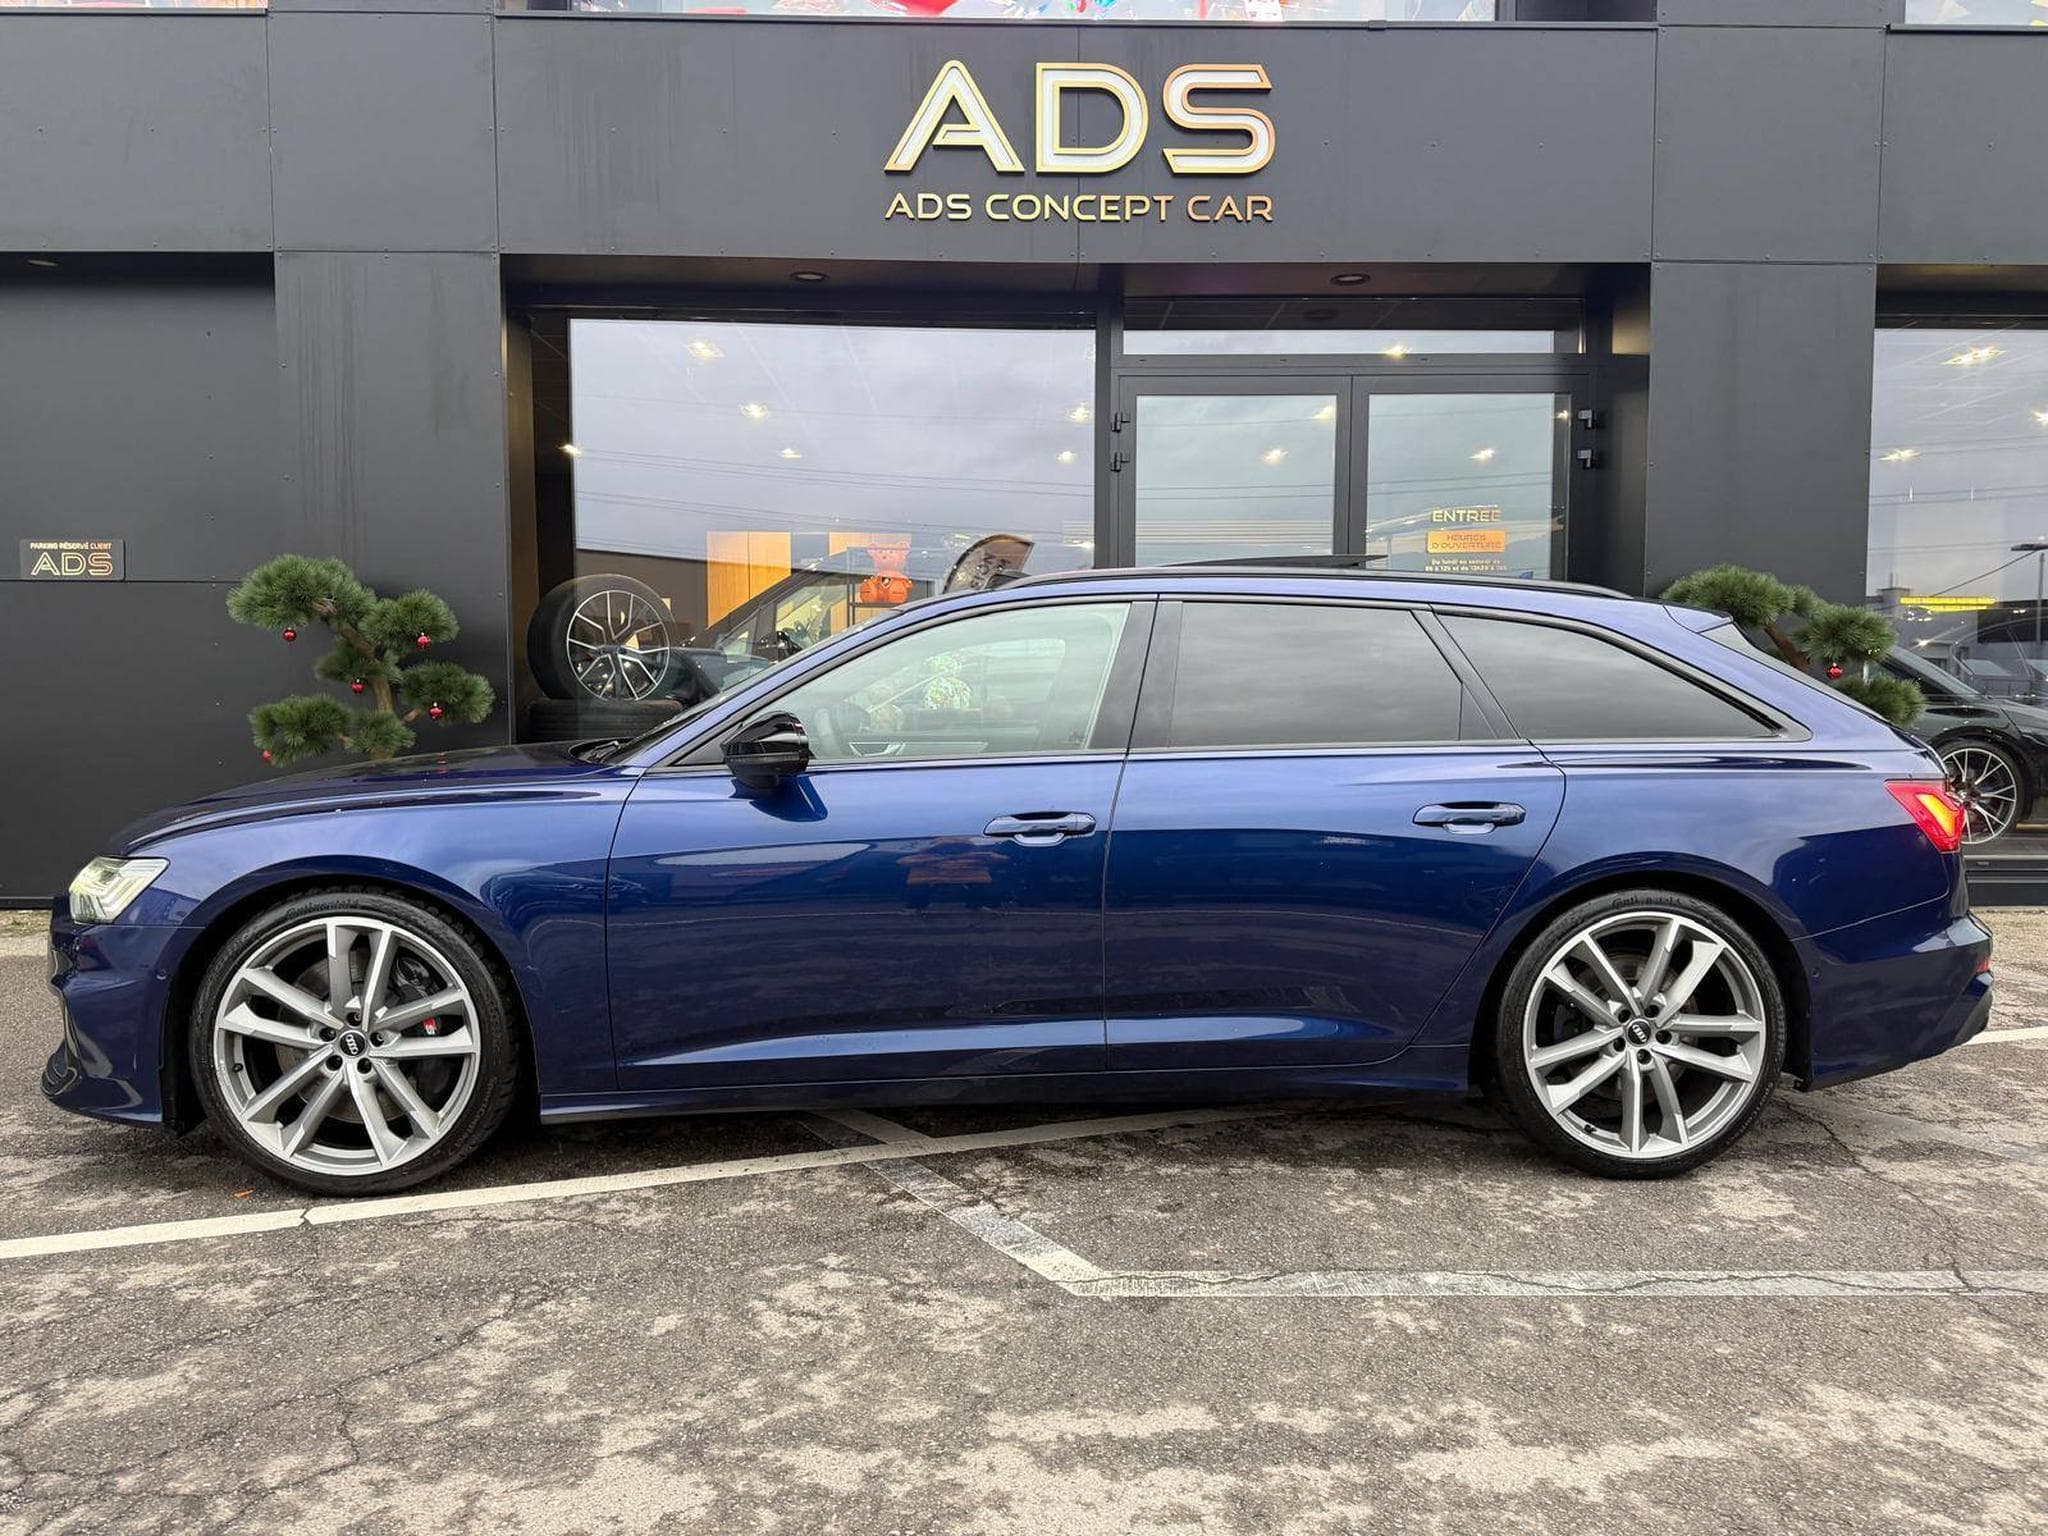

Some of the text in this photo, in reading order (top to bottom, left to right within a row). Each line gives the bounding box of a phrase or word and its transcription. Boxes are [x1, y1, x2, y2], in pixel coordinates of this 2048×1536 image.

[884, 59, 1277, 174] ADS
[884, 193, 1273, 222] ADS CONCEPT CAR
[30, 542, 58, 550] PARKING
[90, 542, 113, 550] CLIENT
[30, 551, 113, 576] ADS
